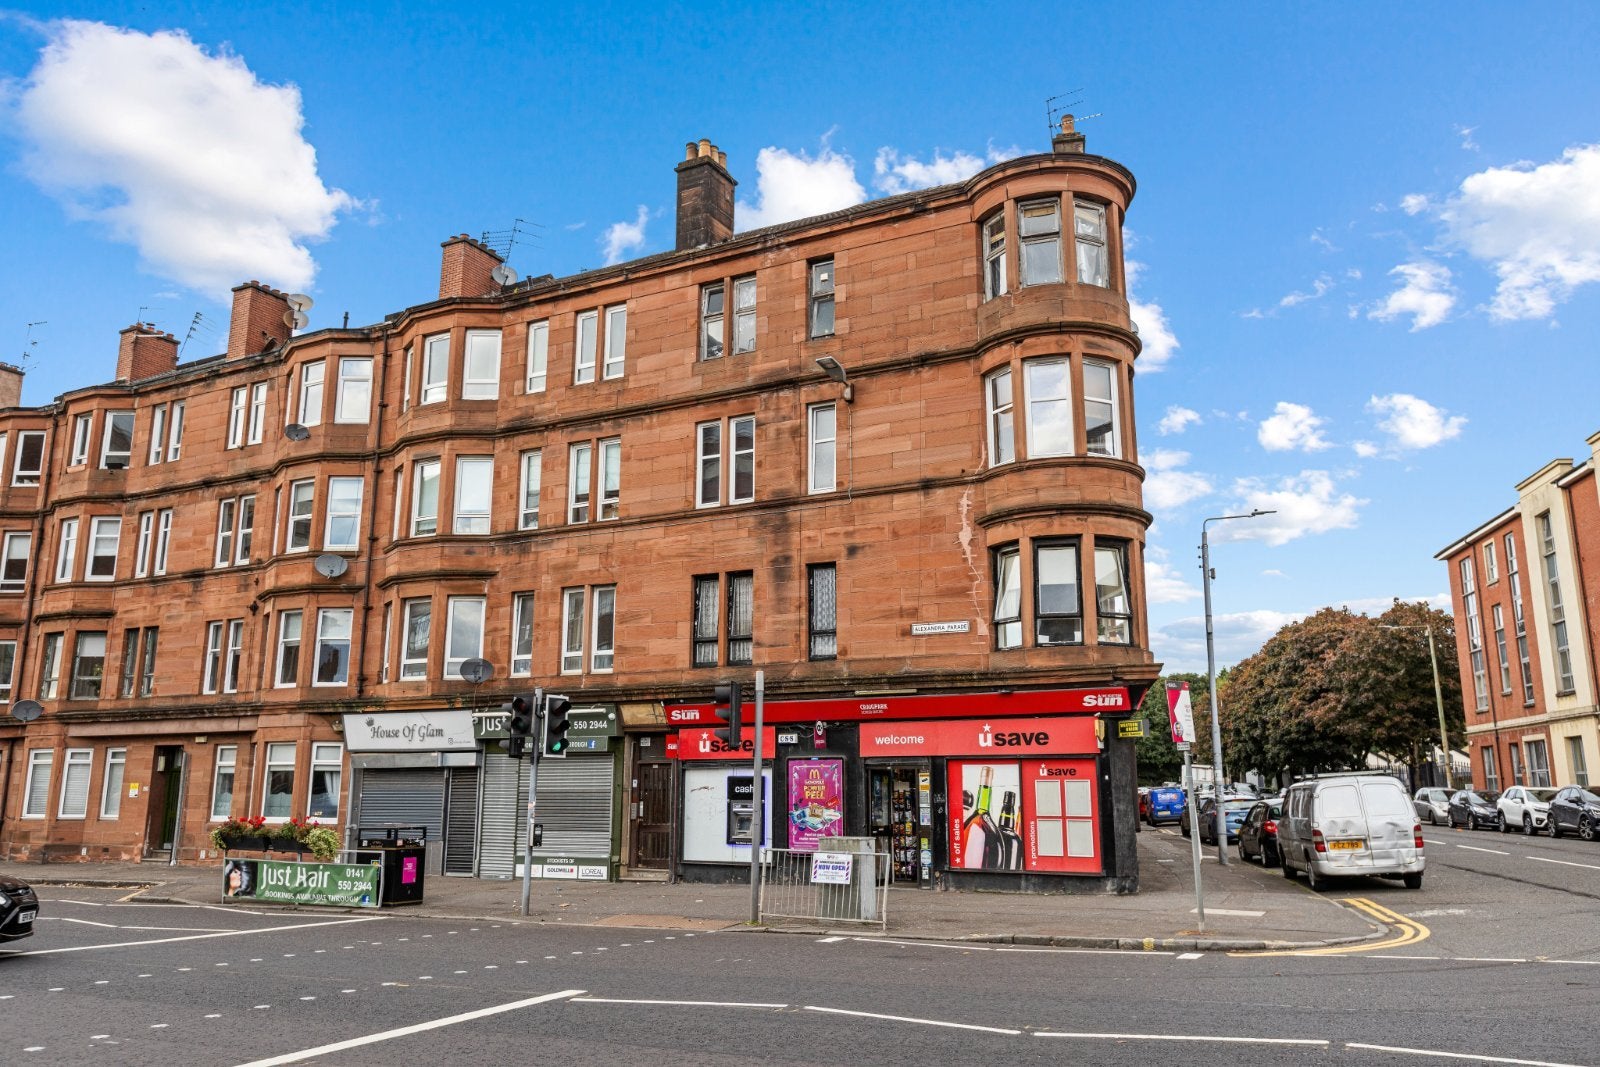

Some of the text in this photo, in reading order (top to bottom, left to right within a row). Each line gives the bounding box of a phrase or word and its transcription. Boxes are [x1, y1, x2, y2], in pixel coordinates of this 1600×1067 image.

[1082, 695, 1123, 706] Sun
[671, 710, 700, 720] Sun
[574, 721, 587, 730] 550
[589, 721, 608, 729] 2944
[371, 724, 444, 742] House Of Glam
[875, 735, 925, 745] welcome
[734, 784, 754, 793] cash
[260, 864, 331, 889] Just Hair
[346, 869, 364, 878] 0141
[338, 881, 372, 891] 550 2944
[265, 890, 295, 899] BOOKINGS
[295, 893, 326, 901] AVAILABLE
[327, 894, 359, 903] THROUGH
